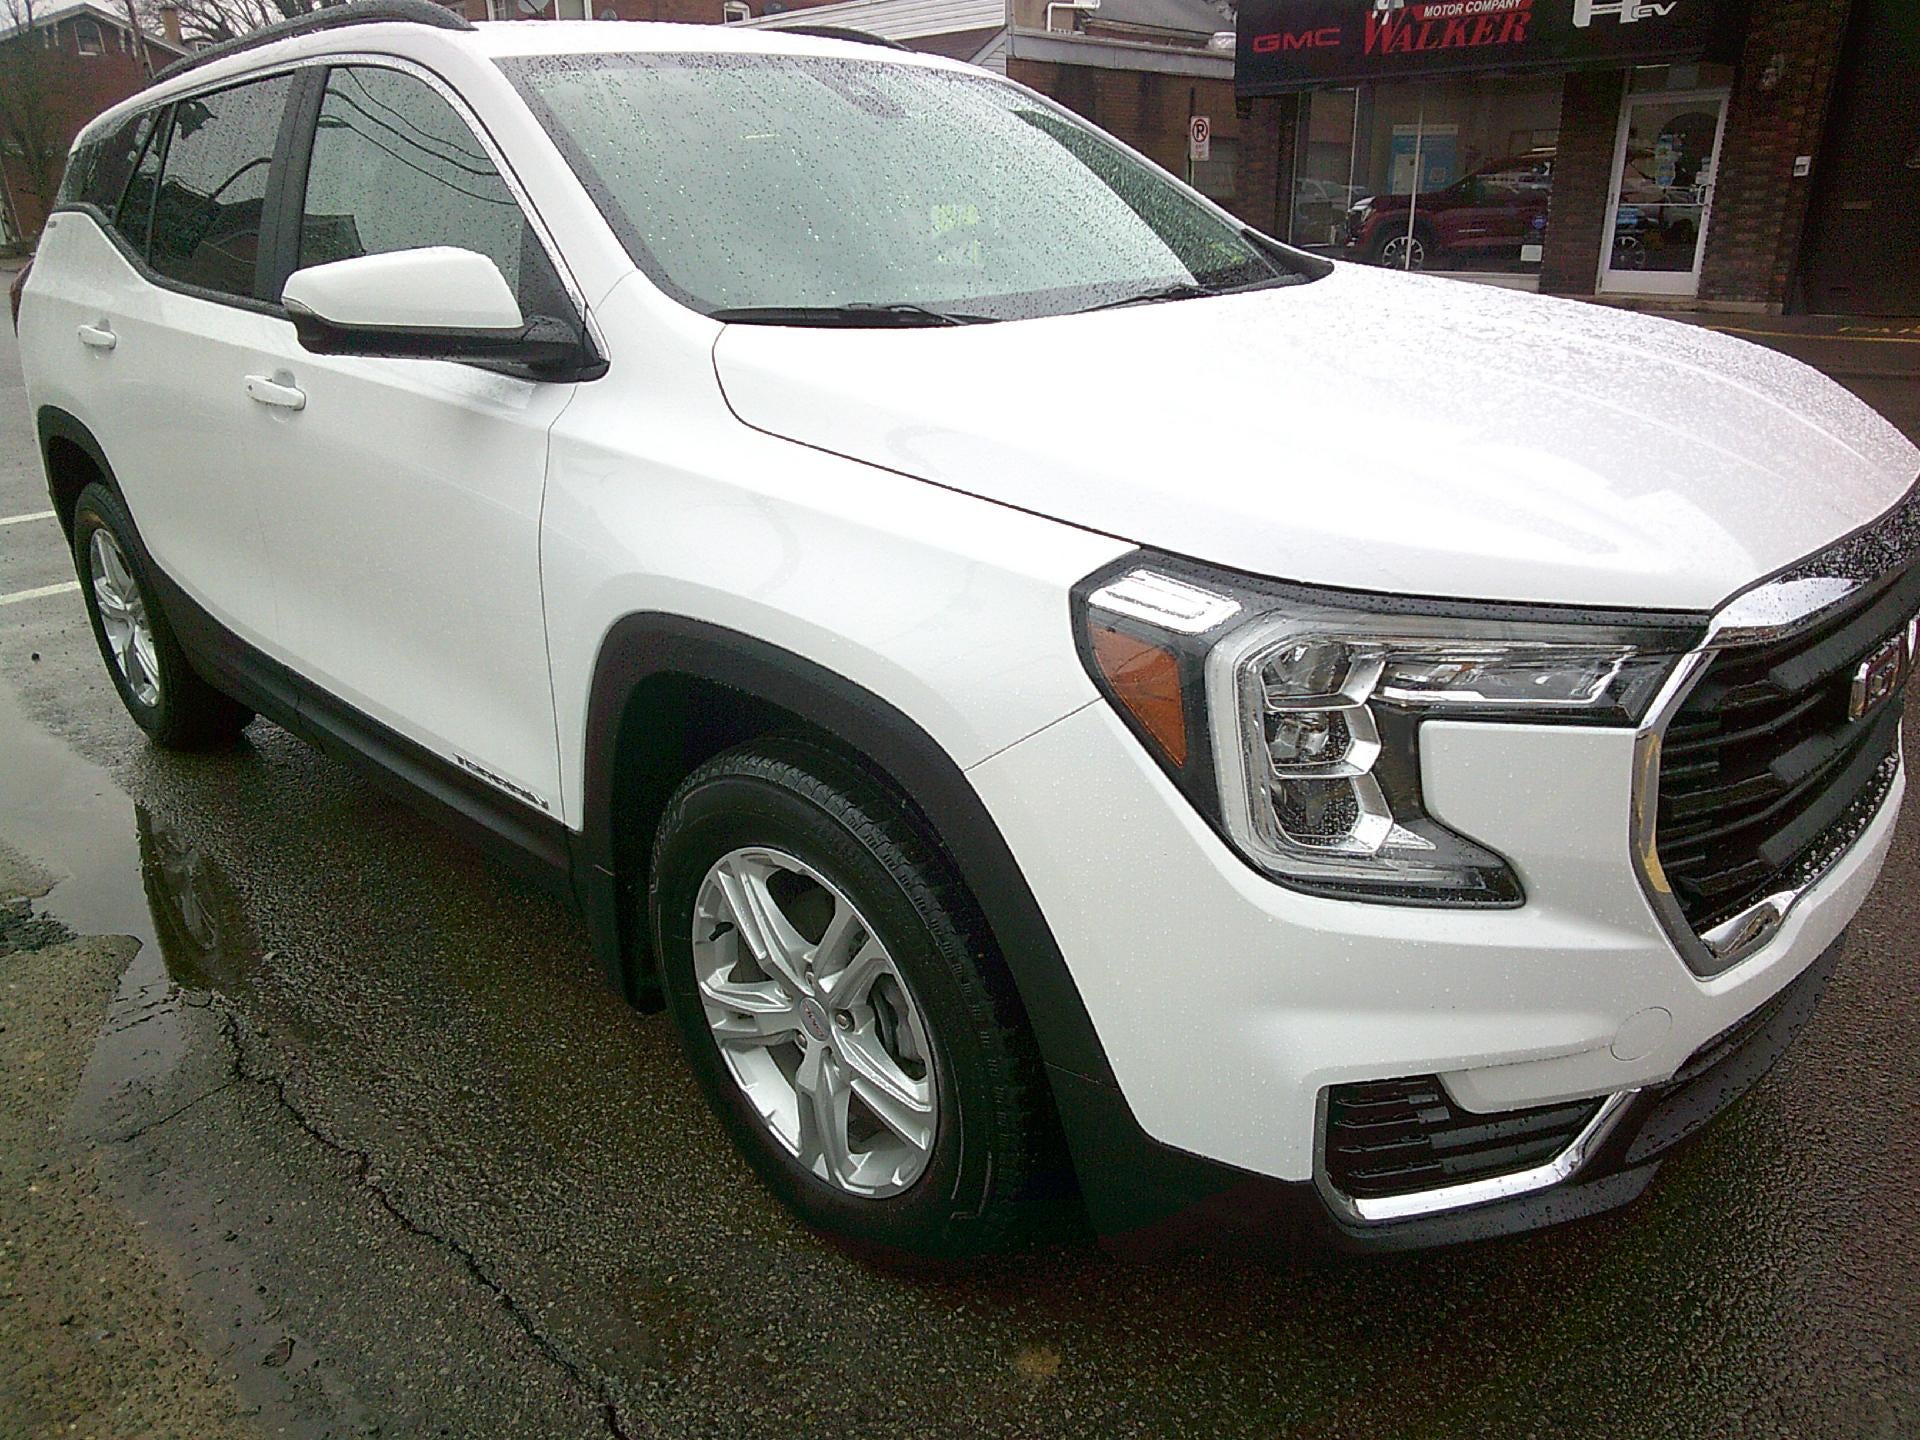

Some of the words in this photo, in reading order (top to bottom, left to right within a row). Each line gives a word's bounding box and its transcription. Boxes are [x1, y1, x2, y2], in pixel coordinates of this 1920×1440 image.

[1423, 2, 1463, 17] MOTOR
[1465, 0, 1522, 13] COMPANY
[1252, 26, 1341, 53] GMC
[1365, 7, 1532, 55] WALKER
